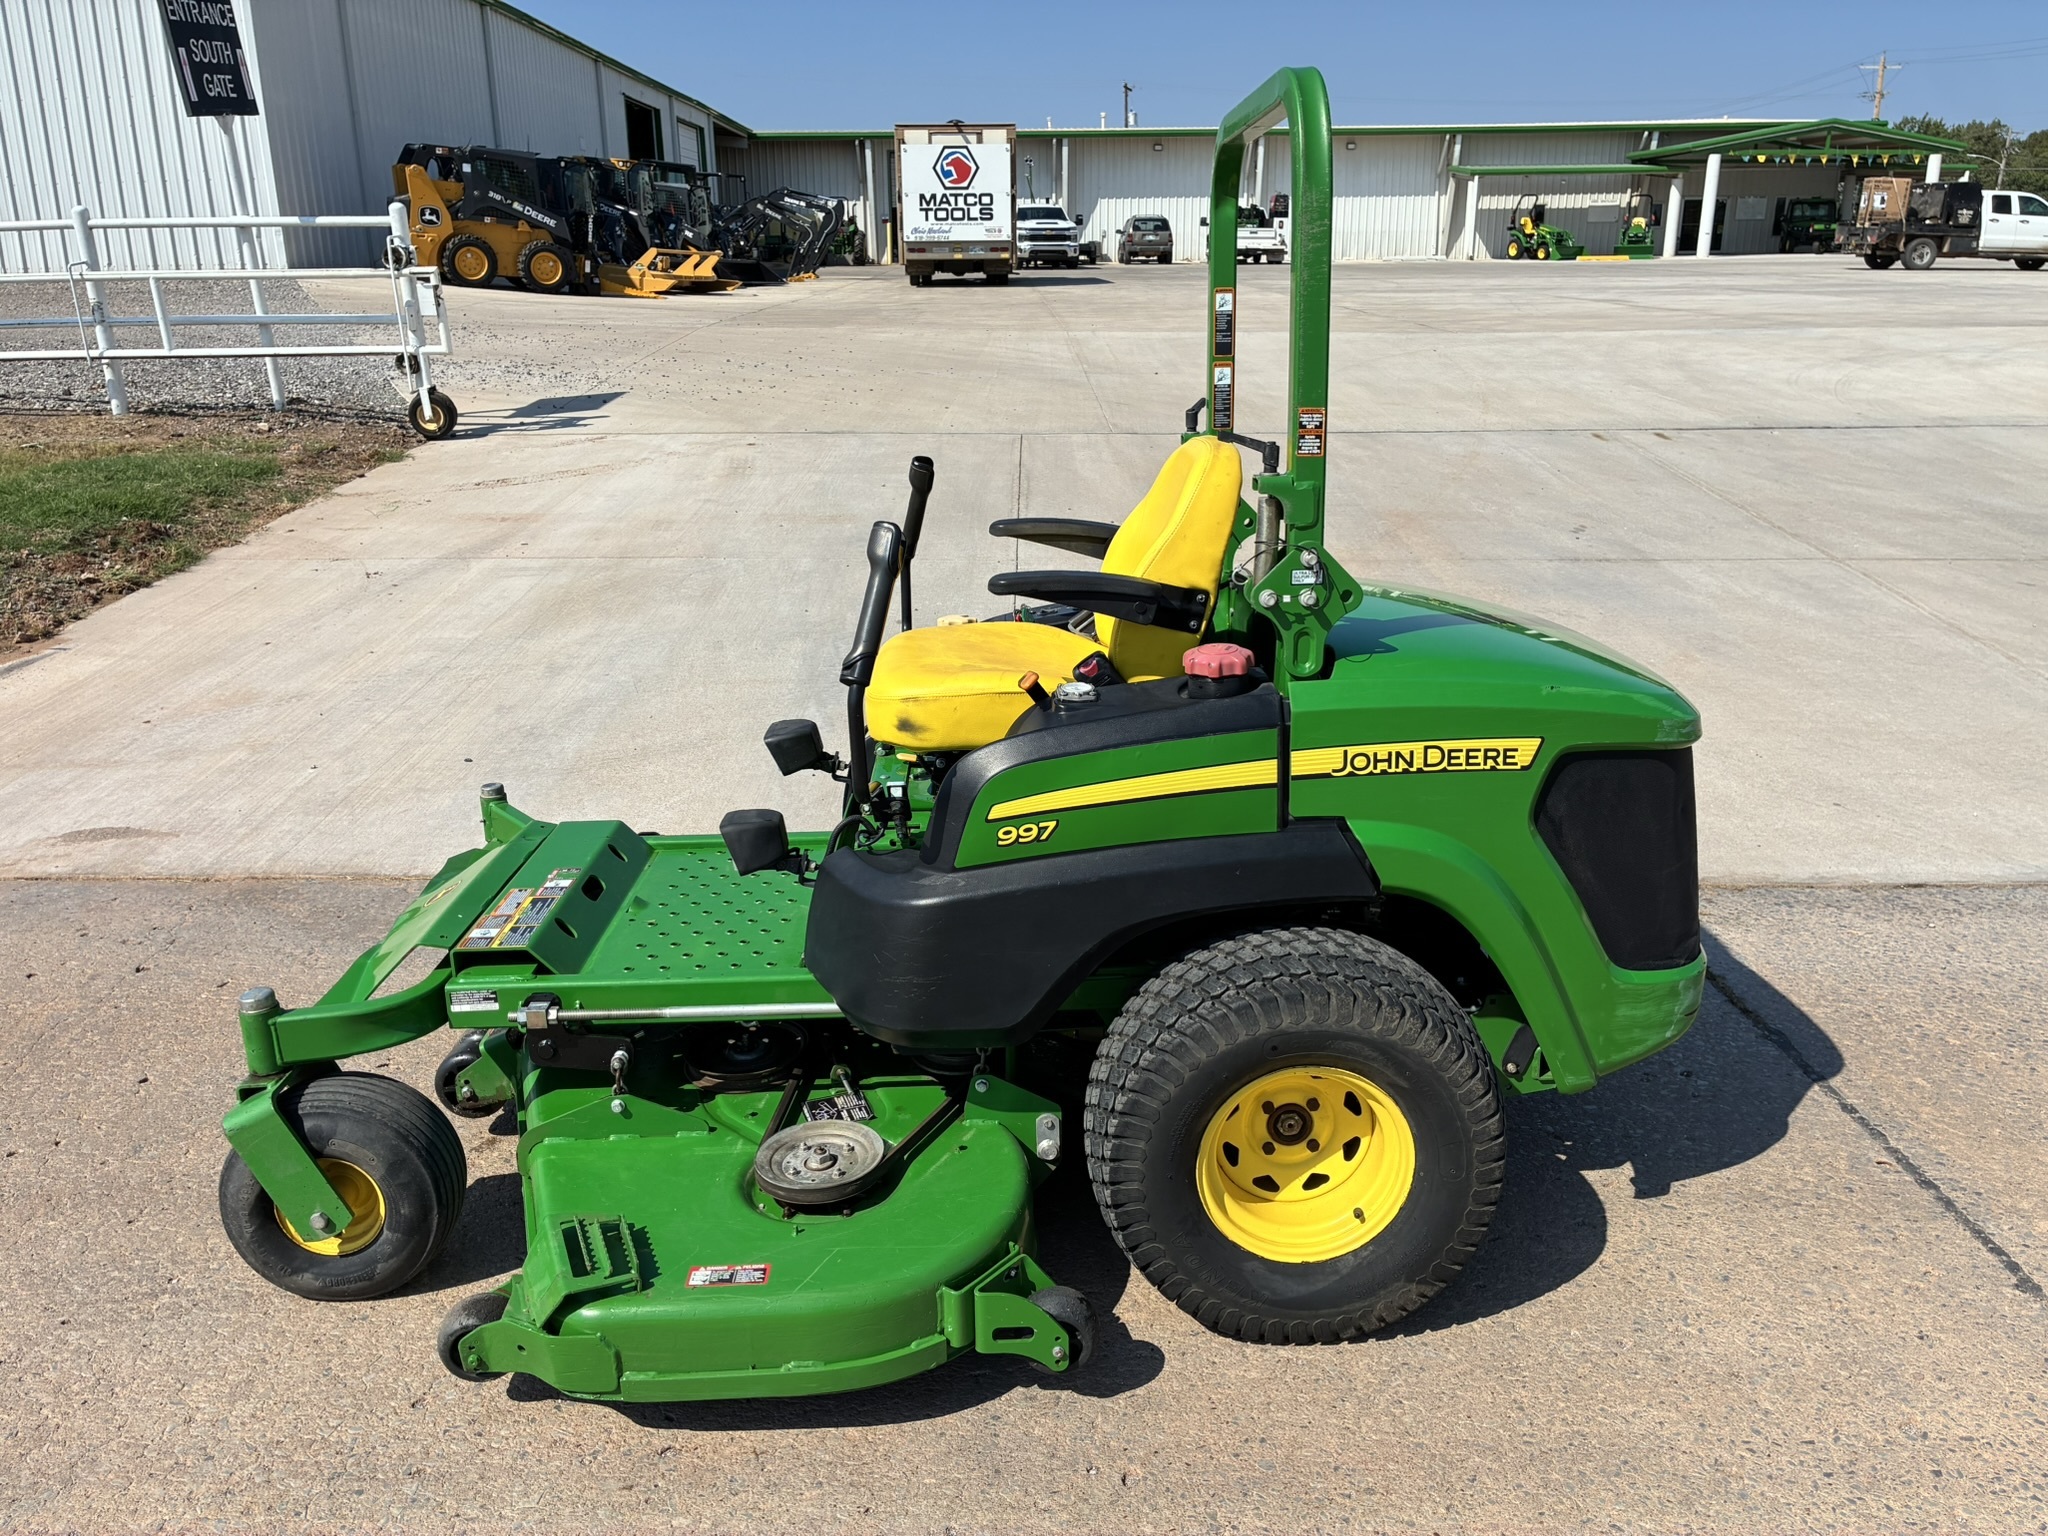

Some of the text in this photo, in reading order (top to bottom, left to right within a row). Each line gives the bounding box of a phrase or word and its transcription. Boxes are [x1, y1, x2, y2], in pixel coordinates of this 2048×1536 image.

[164, 0, 236, 28] ENTRANCE
[189, 38, 234, 65] SOUTH
[202, 73, 238, 98] GATE
[599, 203, 623, 218] DEERE
[919, 193, 994, 207] MATCO
[523, 205, 558, 228] DEERE
[919, 207, 994, 222] TOOLS
[1331, 745, 1522, 776] JOHN DEERE
[996, 820, 1060, 848] 997
